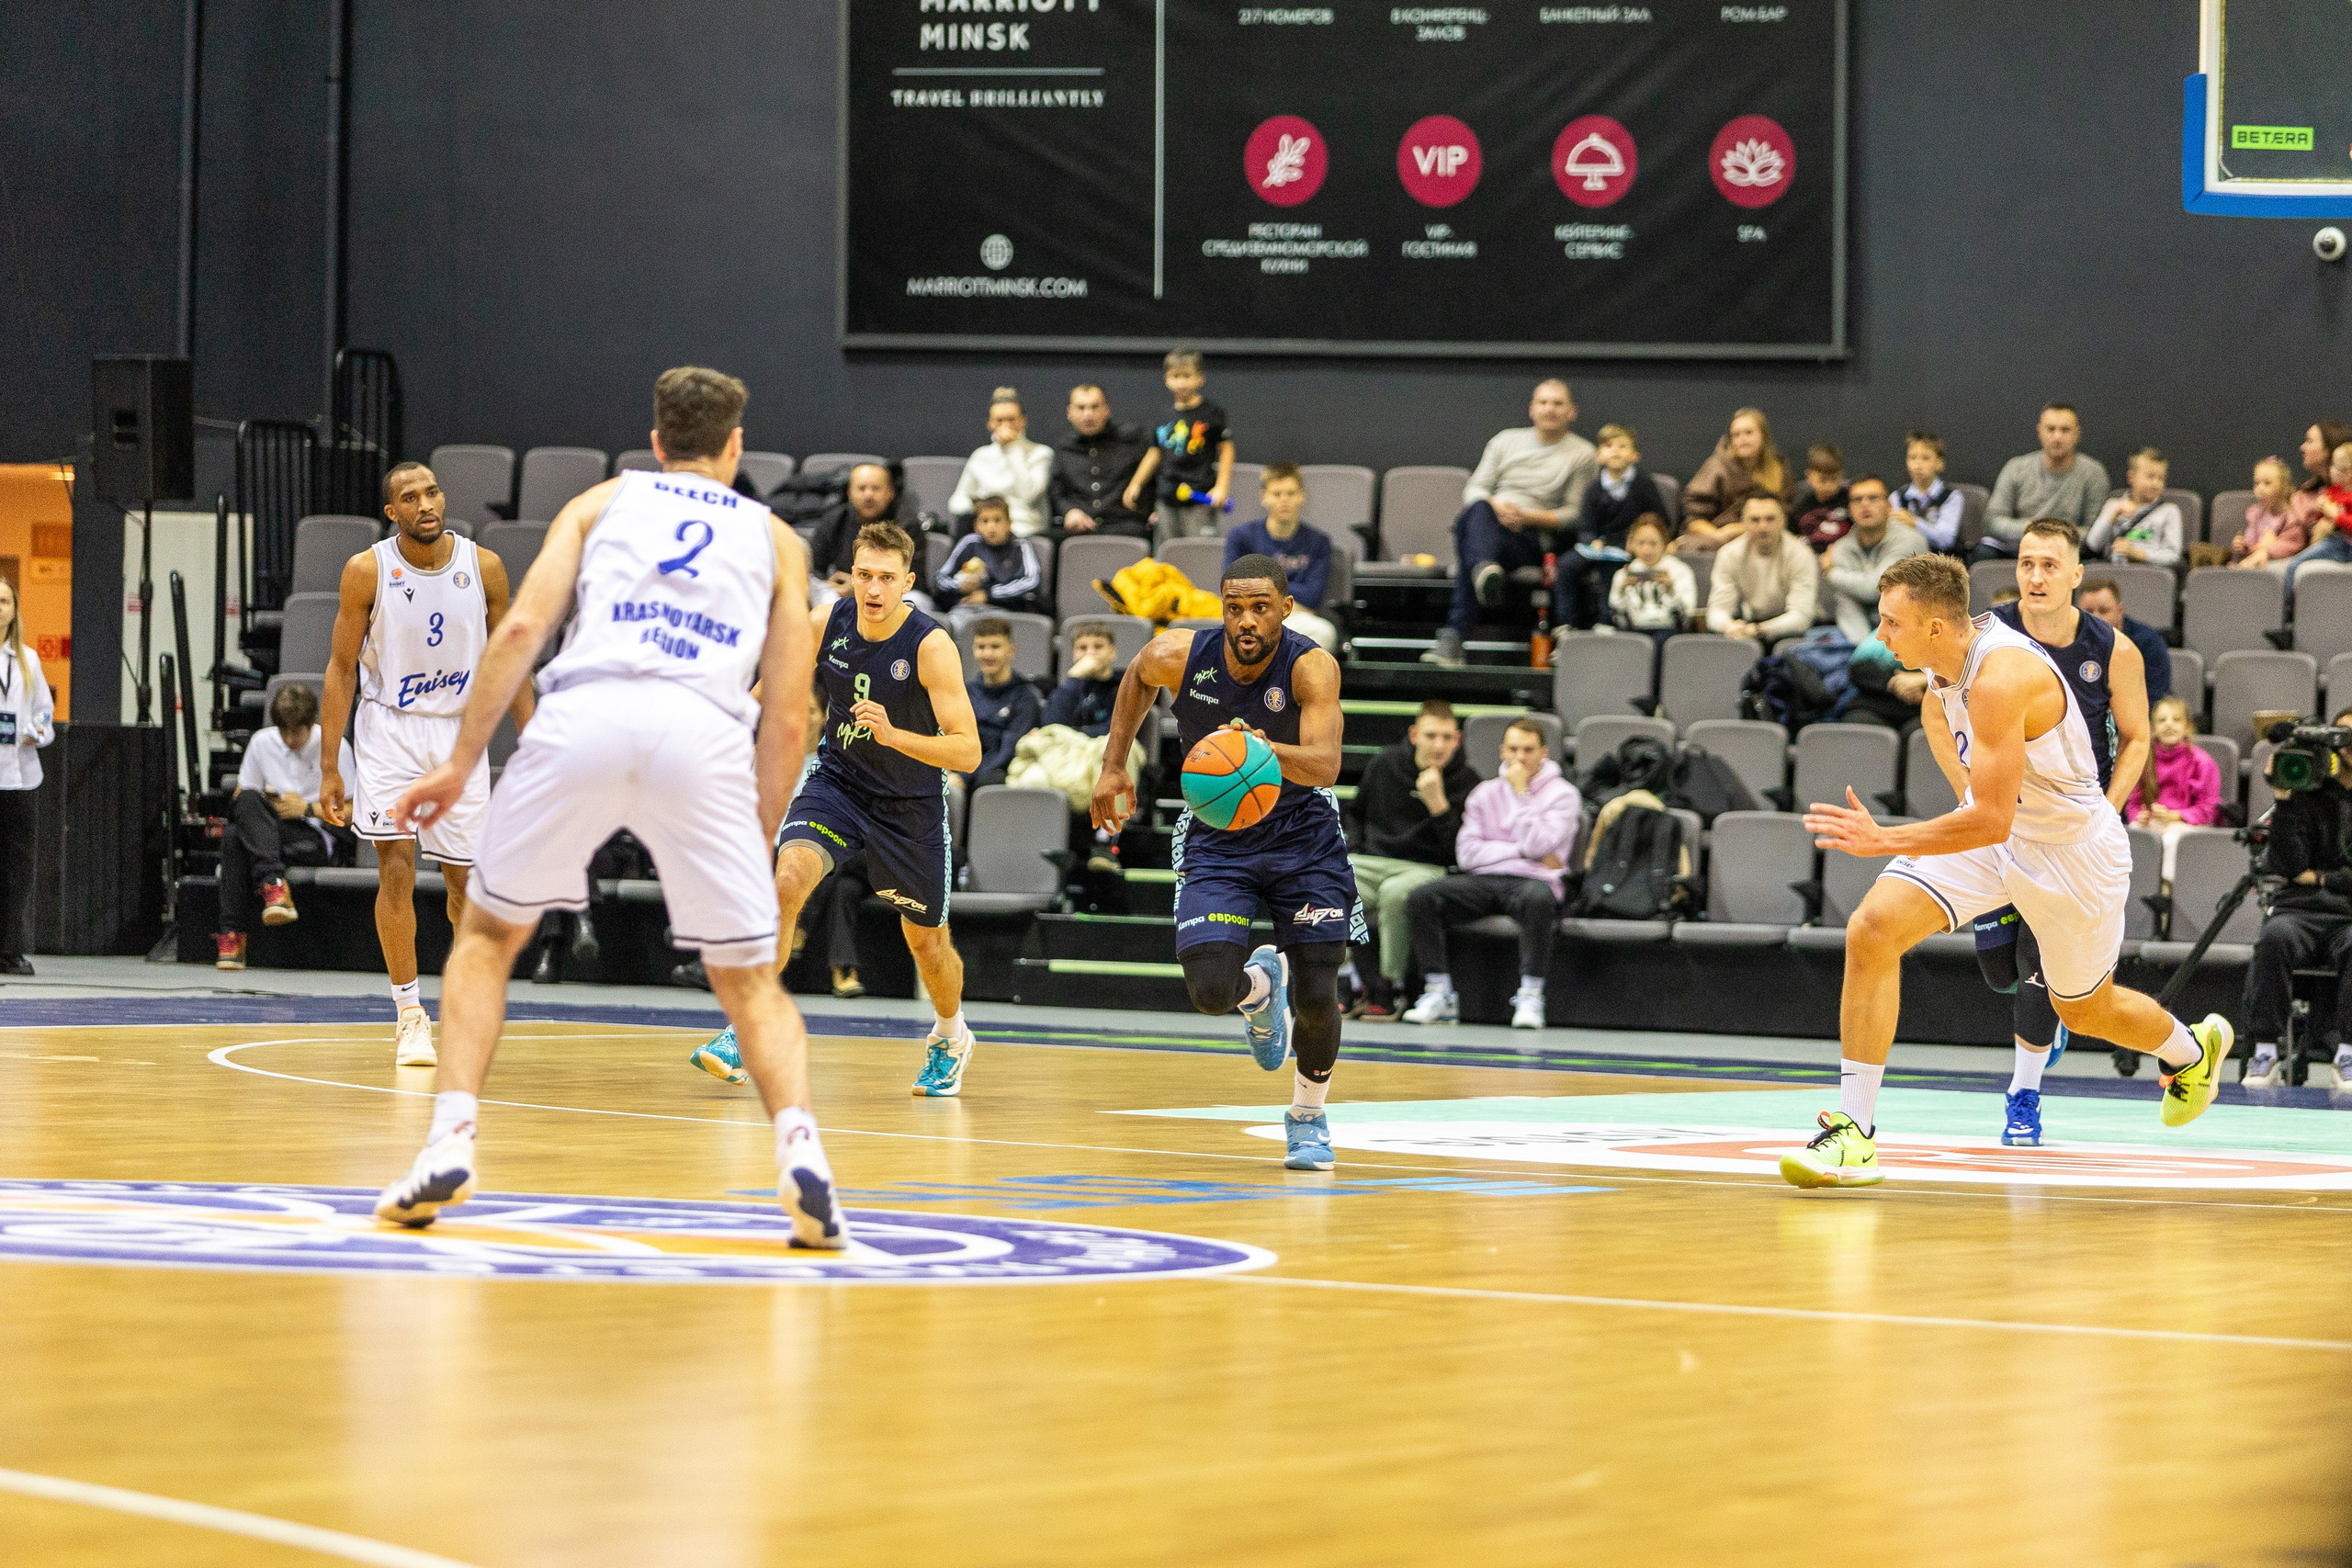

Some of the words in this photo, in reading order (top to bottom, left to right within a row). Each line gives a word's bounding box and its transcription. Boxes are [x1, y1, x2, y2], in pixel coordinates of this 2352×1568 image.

[920, 22, 1030, 51] MINSK
[890, 89, 965, 107] TRAVEL
[969, 89, 1104, 107] BRILLIANTLY
[1413, 146, 1468, 176] VIP
[1249, 223, 1322, 239] РЕСТОРАН
[1737, 225, 1767, 242] SPA
[1202, 239, 1369, 257] СРЕДИЗЕМНОМОРСКОЙ
[1402, 241, 1477, 258] ГОСТИНАЯ
[1565, 242, 1623, 259] СЕРВИС
[1261, 258, 1308, 274] КУХНИ
[907, 276, 1088, 298] MARRIOTTMINSK.COM
[658, 519, 713, 578] 2
[426, 612, 444, 647] 3
[612, 601, 741, 647] KRASNOYARSK
[829, 653, 849, 669] Kempa
[398, 670, 470, 707] Enisey
[854, 672, 871, 703] 9
[1190, 688, 1219, 705] Kempa
[1178, 915, 1204, 931] Kempa
